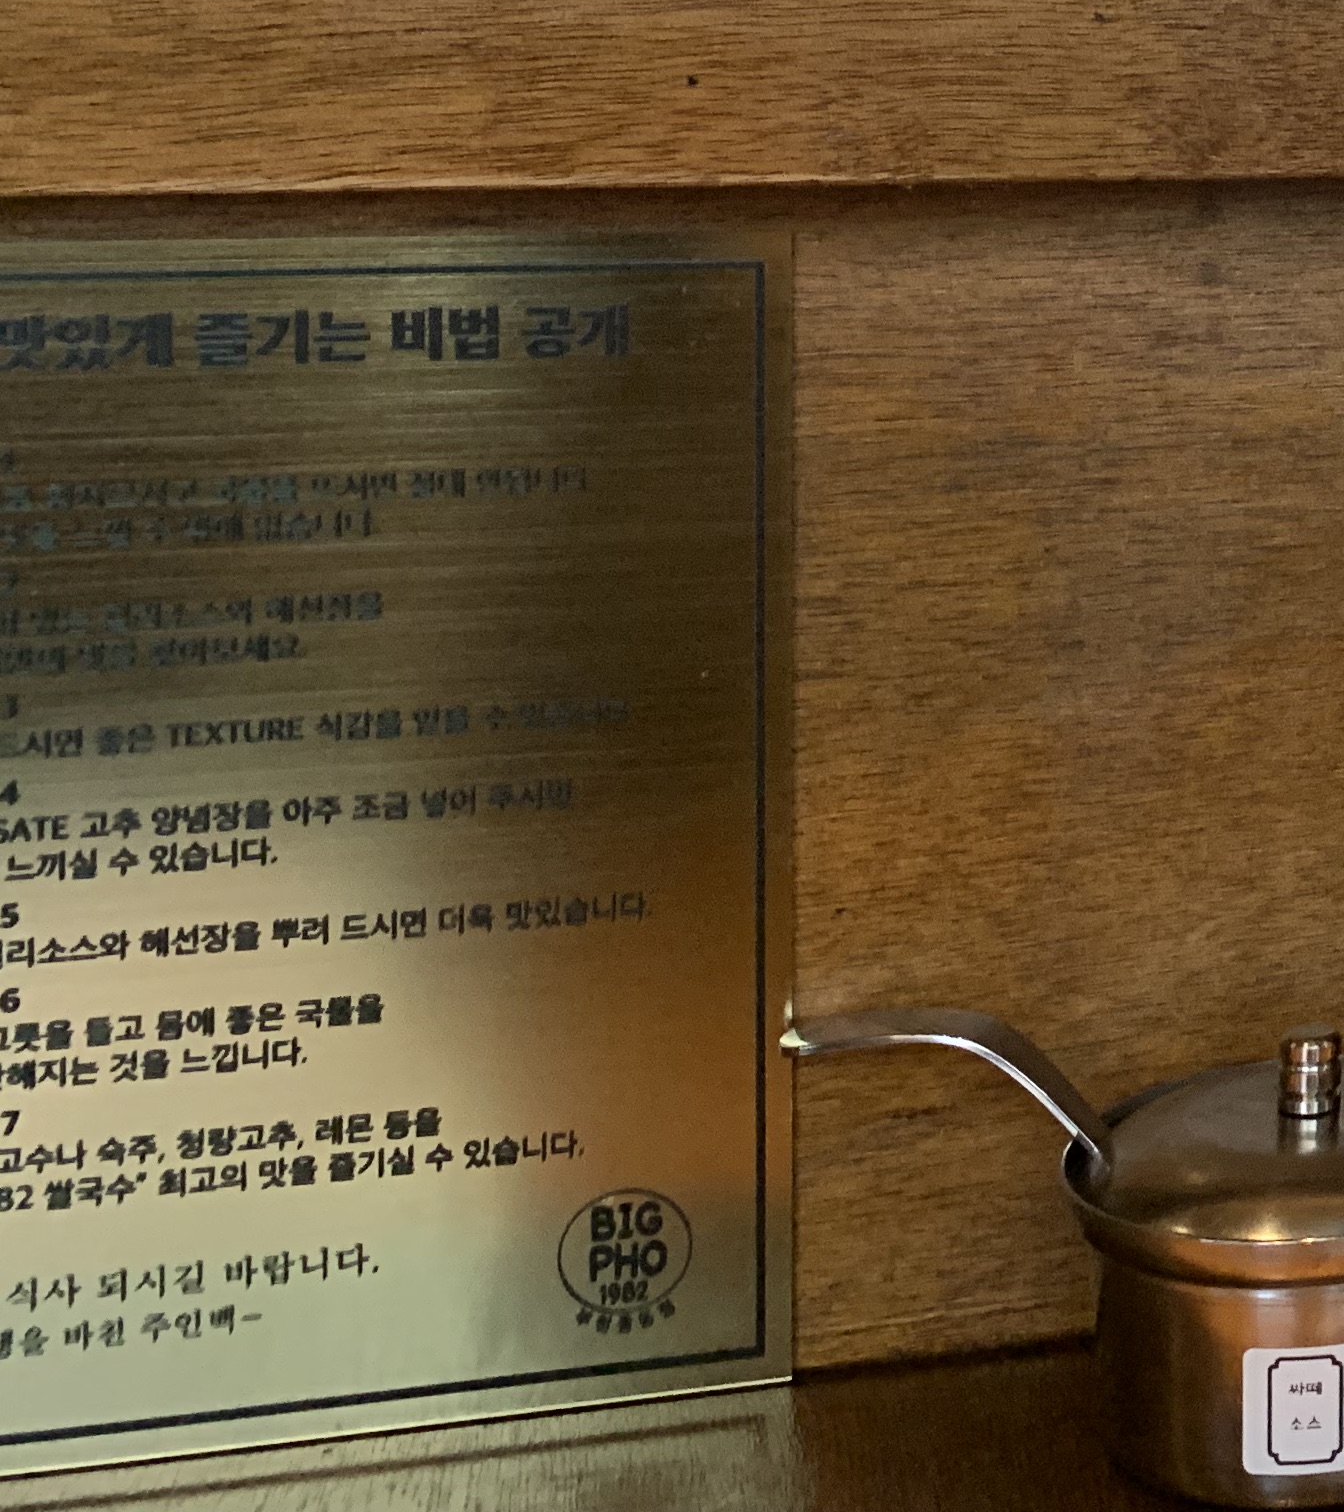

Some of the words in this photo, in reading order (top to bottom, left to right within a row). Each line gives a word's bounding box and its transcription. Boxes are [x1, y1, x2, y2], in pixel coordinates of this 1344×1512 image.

[0, 311, 174, 370] 맛있게
[196, 309, 371, 365] 즐기는
[391, 305, 499, 361] 비법
[521, 302, 630, 358] 공개
[167, 716, 304, 748] TEXTURE
[80, 807, 142, 838] 고추
[152, 799, 273, 835] 양념장을
[282, 795, 342, 828] 아주
[353, 791, 409, 821] 조금
[4, 847, 98, 881] 느끼실
[109, 846, 139, 876] 수
[149, 836, 278, 874] 있습니다.
[0, 902, 20, 929] 5
[140, 920, 261, 958] 해선장을
[271, 913, 330, 949] 뿌려
[340, 908, 426, 940] 드시면
[86, 1015, 145, 1047] 들고
[157, 1006, 216, 1041] 몸에
[226, 1002, 286, 1035] 좋은
[295, 992, 384, 1028] 국물을
[109, 1048, 170, 1083] 것을
[180, 1036, 309, 1073] 느낍니다.
[0, 1109, 21, 1136] 7
[97, 1134, 166, 1164] 숙주,
[315, 1112, 374, 1145] 레몬
[384, 1106, 442, 1139] 등을
[158, 1161, 248, 1198] 최고의
[258, 1154, 318, 1190] 맛을
[425, 1142, 454, 1173] 수
[591, 1200, 664, 1242] BIG
[7, 1266, 82, 1313] 식사
[224, 1242, 380, 1290] 바랍니다.
[588, 1239, 668, 1283] PHO
[1291, 1416, 1322, 1431] 소스
